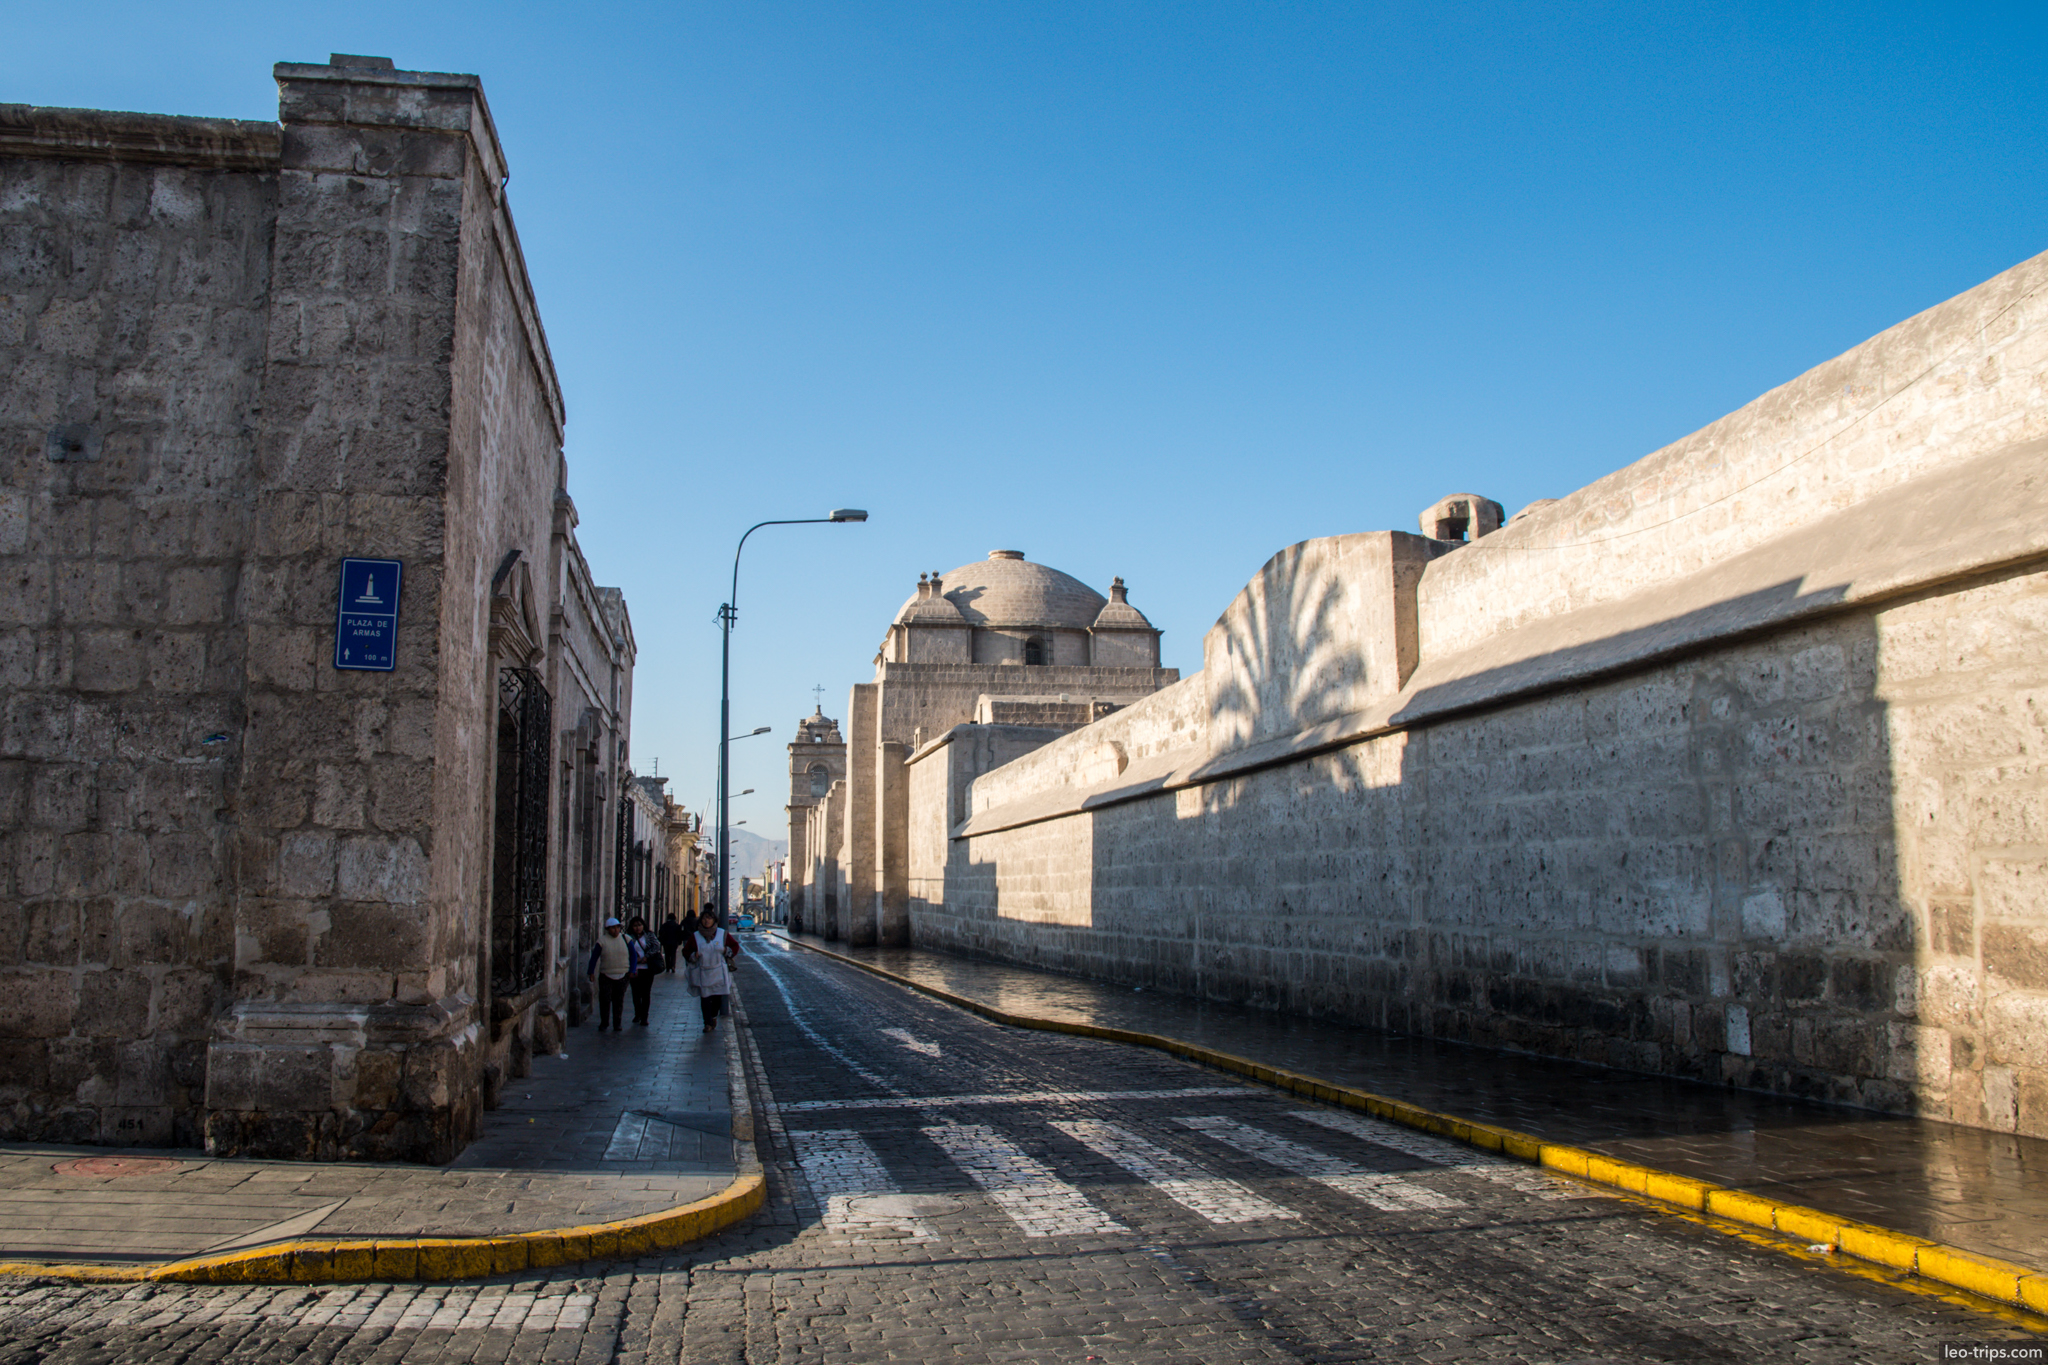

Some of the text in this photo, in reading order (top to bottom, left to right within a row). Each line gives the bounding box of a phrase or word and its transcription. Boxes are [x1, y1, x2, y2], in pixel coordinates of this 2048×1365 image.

[347, 619, 388, 628] PLAZA DE
[352, 629, 381, 637] ARMAS
[118, 1119, 144, 1130] 451
